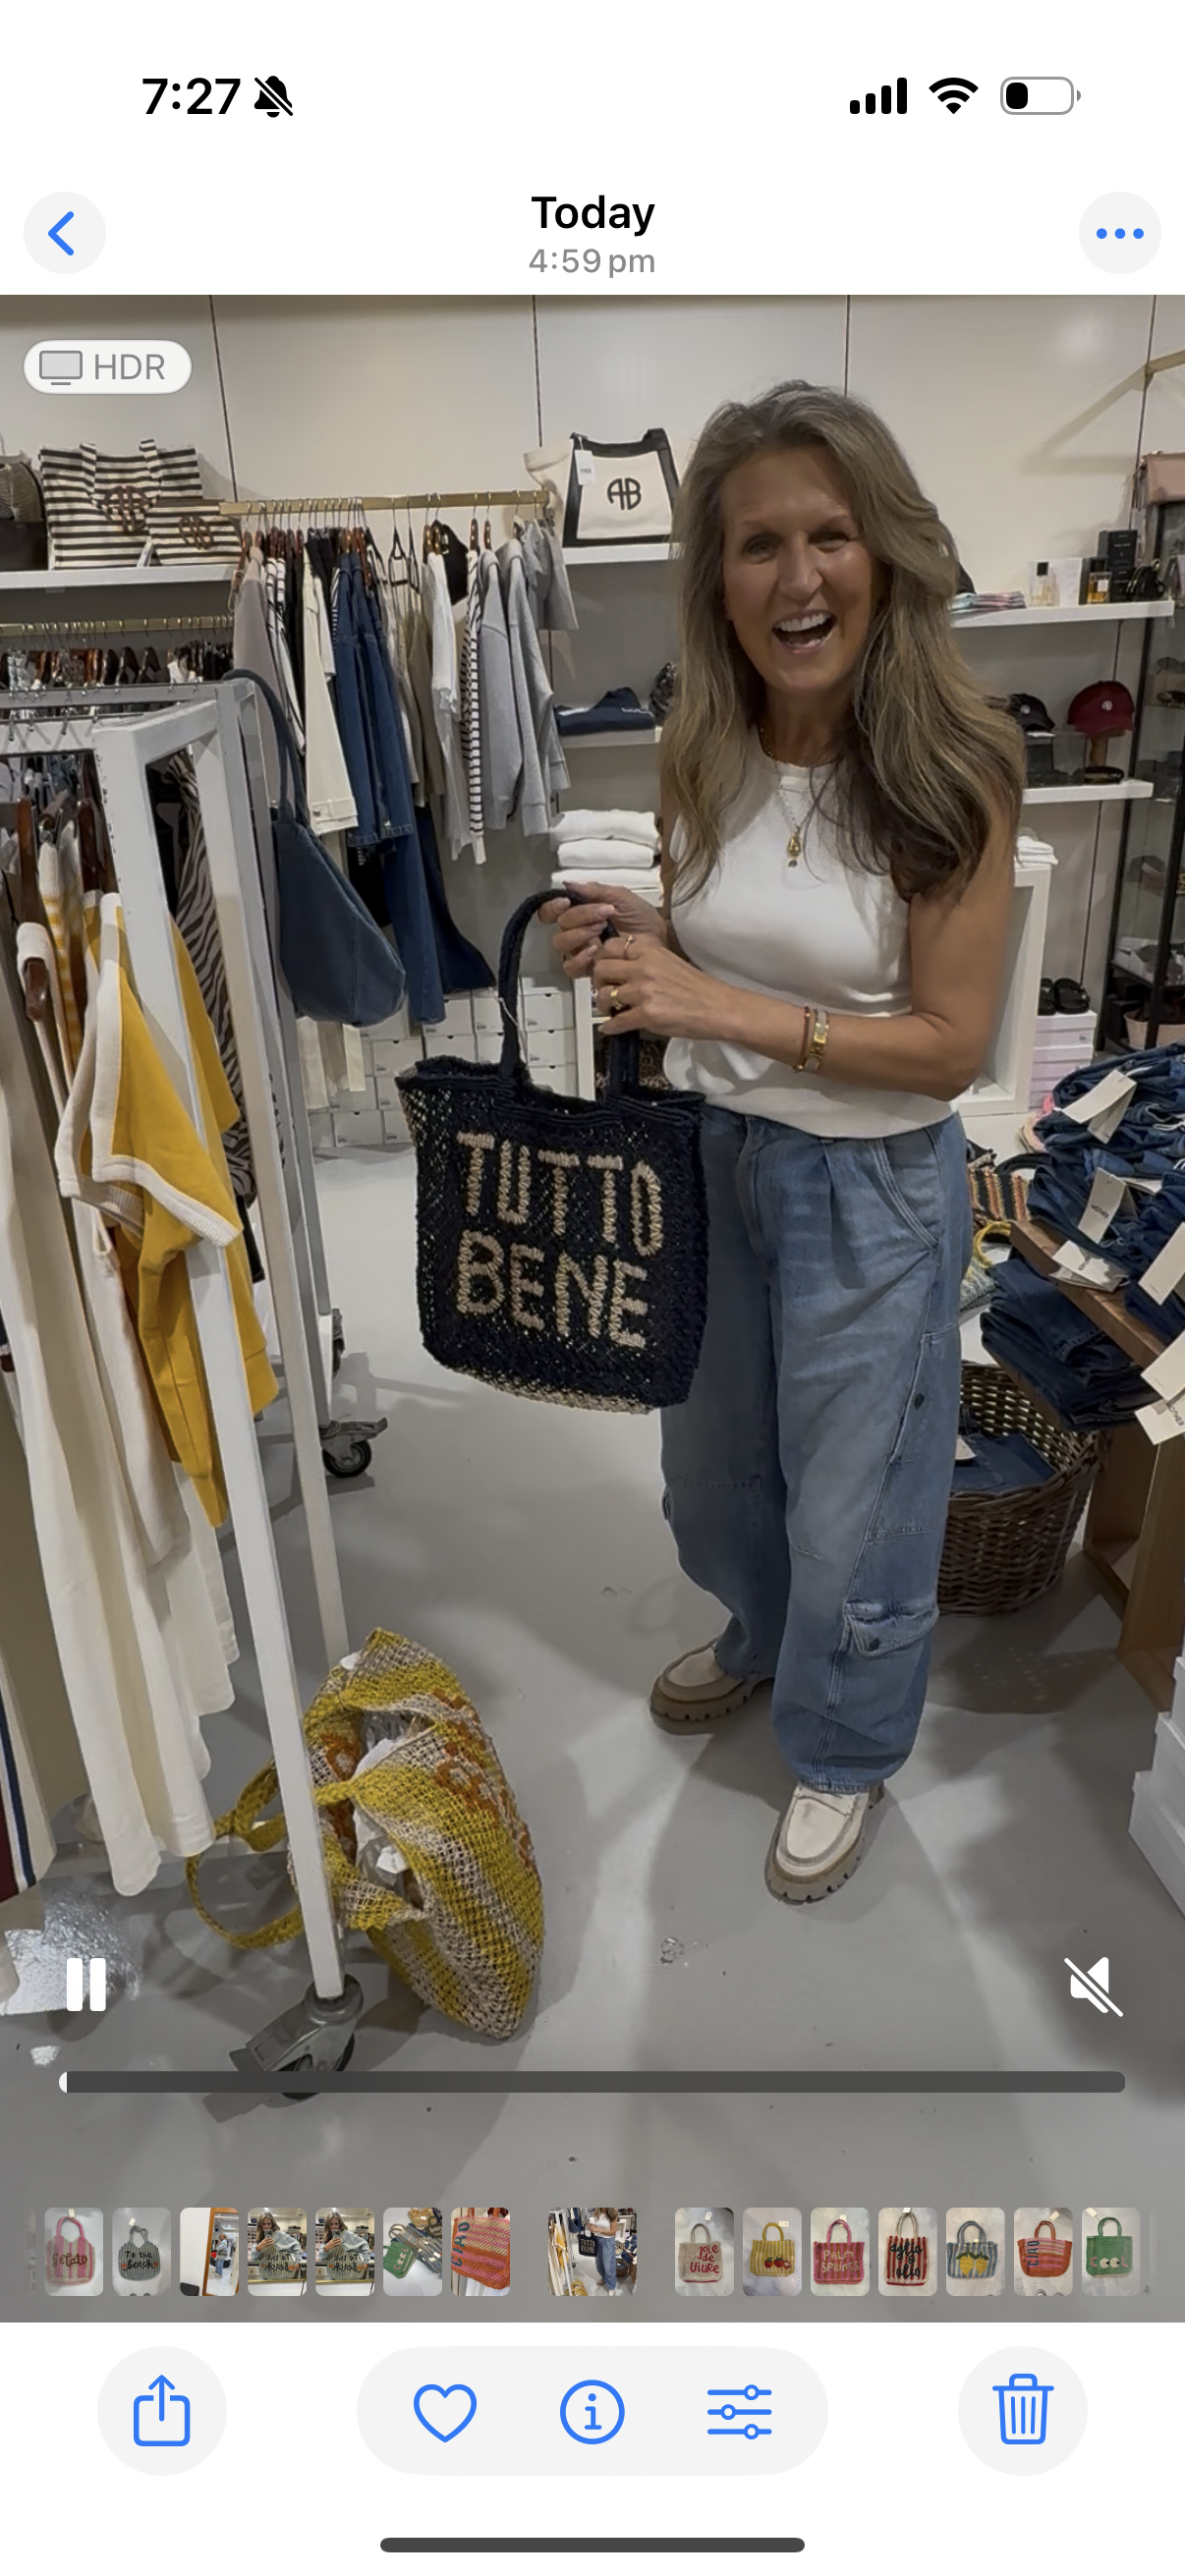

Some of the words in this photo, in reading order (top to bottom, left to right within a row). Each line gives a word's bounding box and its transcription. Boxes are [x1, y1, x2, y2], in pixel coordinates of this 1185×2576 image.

[606, 476, 643, 512] AB
[456, 1131, 665, 1258] TUTTO
[456, 1230, 649, 1350] BENE
[1166, 1405, 1185, 1427] OTHER
[702, 2253, 715, 2263] de
